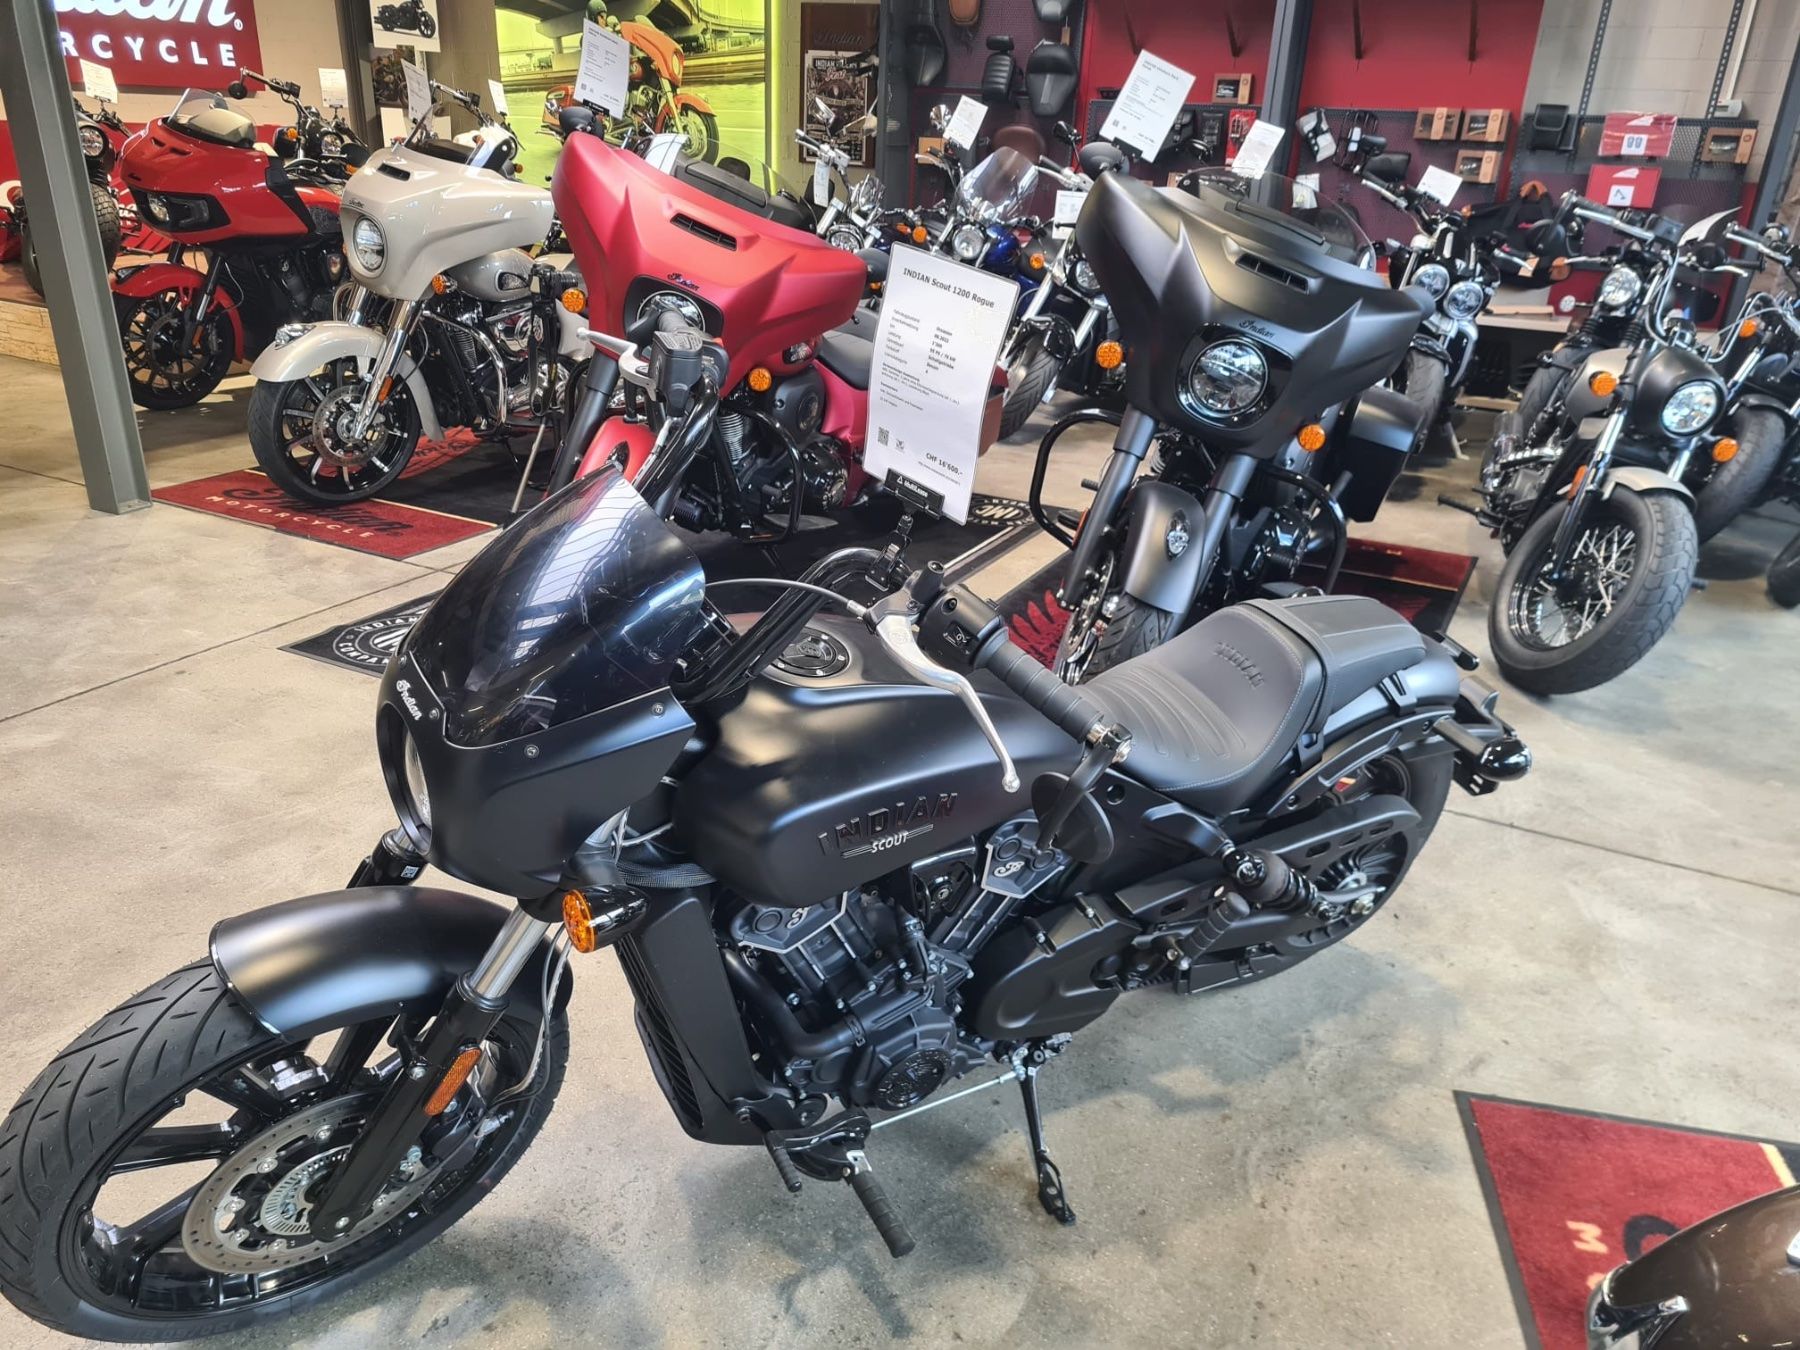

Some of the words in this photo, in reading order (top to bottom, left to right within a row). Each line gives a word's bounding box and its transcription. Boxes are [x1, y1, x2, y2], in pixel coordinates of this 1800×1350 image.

[903, 267, 931, 284] INDIAN
[931, 278, 952, 293] Scout
[953, 286, 971, 299] 1200
[971, 293, 995, 309] Rogue
[1239, 319, 1276, 339] Indian
[926, 452, 938, 463] CHF
[205, 495, 375, 539] MOTORCYCLE
[396, 679, 423, 721] Indian
[817, 792, 958, 856] INDIAN
[870, 829, 910, 854] SCOUT
